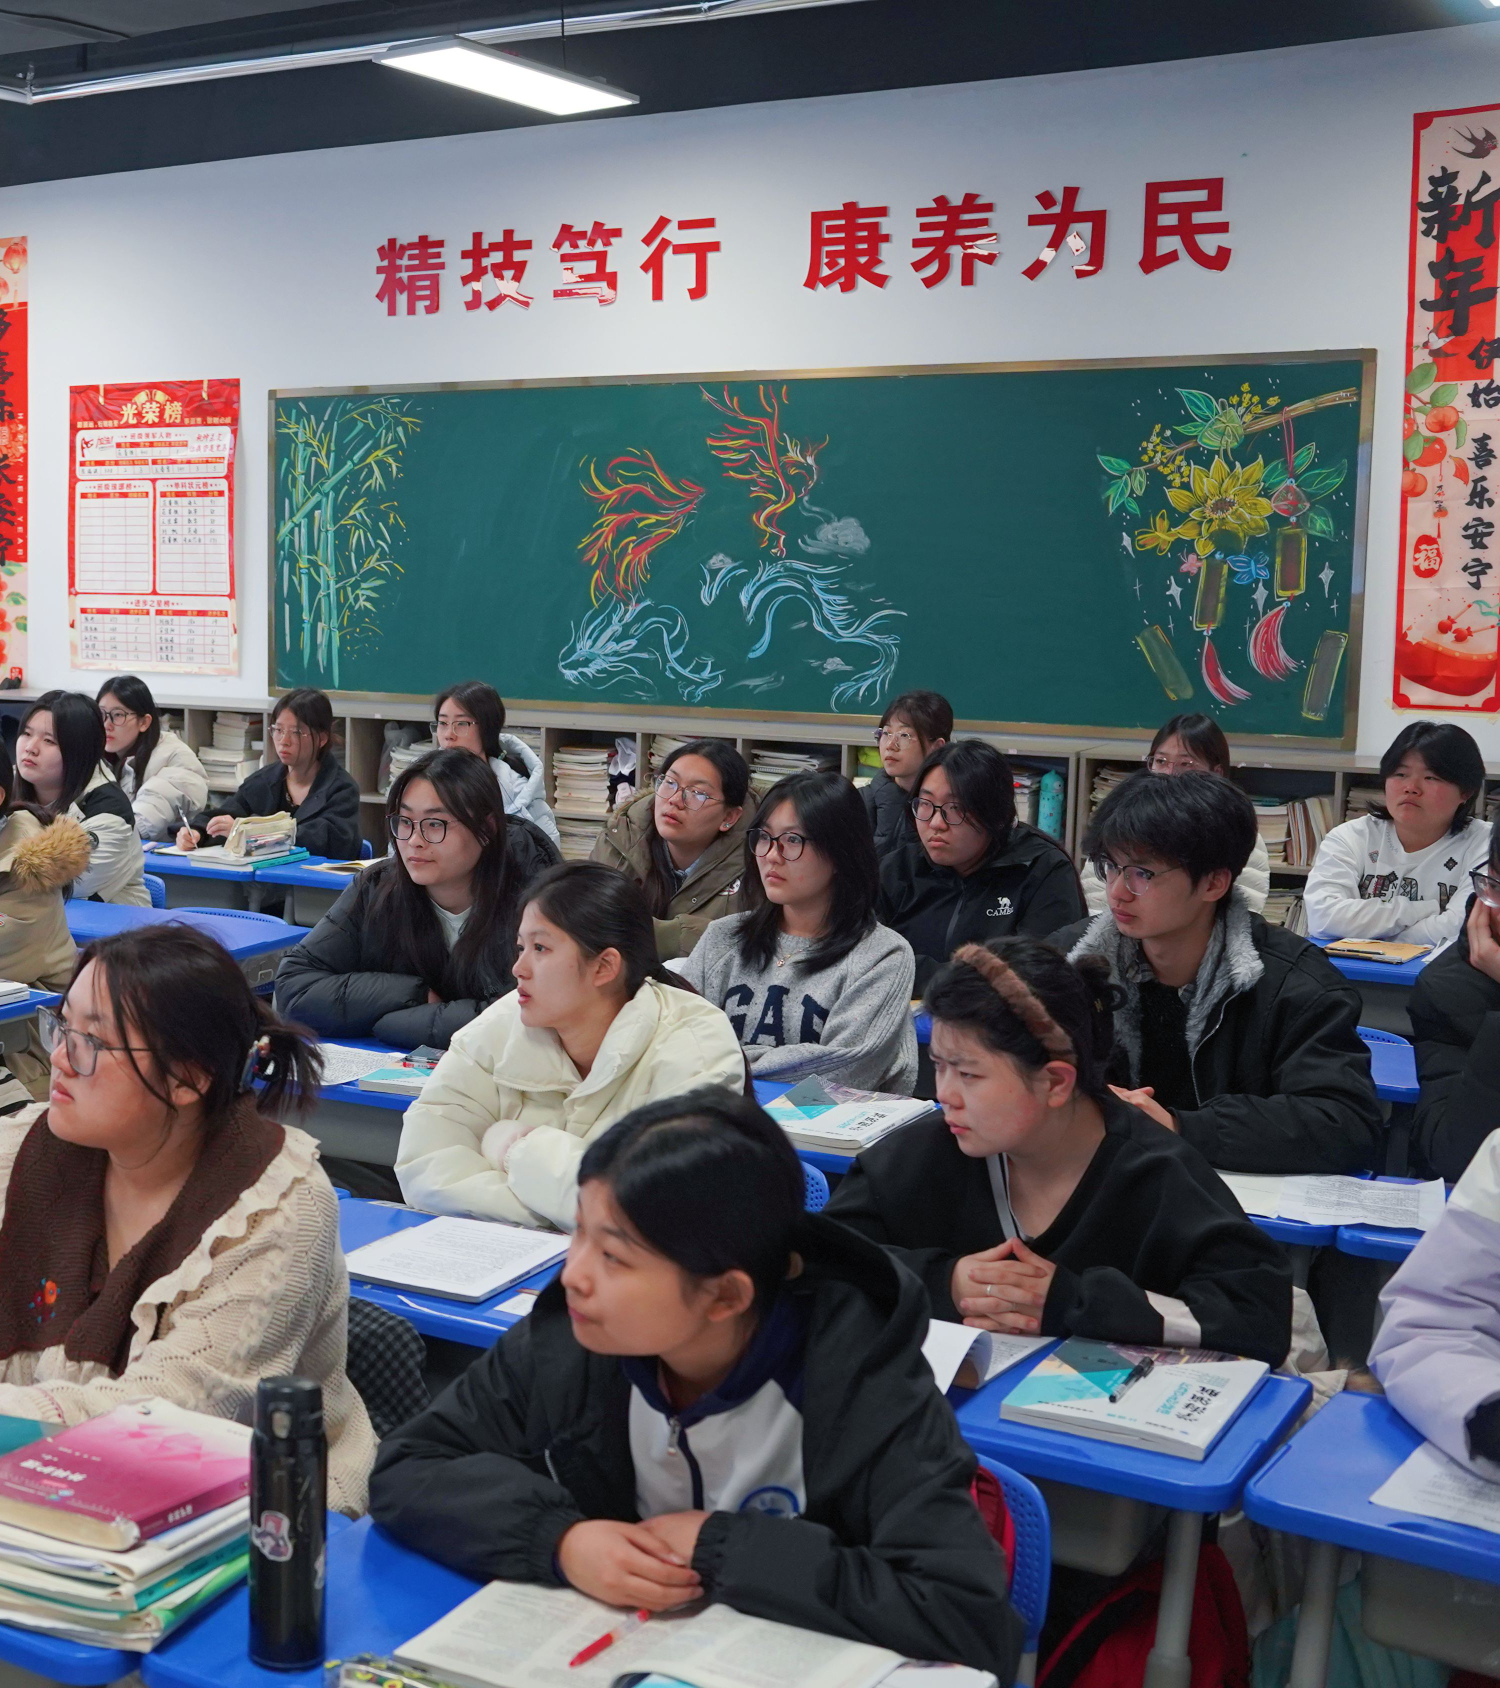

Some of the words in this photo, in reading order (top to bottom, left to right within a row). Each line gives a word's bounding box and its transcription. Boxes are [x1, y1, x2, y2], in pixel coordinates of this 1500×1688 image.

[375, 214, 722, 317] 精技笃行
[803, 177, 1234, 293] 康养为民
[1416, 165, 1500, 337] 新年
[17, 412, 25, 463] HAPPY
[120, 401, 183, 425] 光荣榜
[1414, 543, 1441, 572] 福
[1461, 432, 1498, 591] 喜乐安宁
